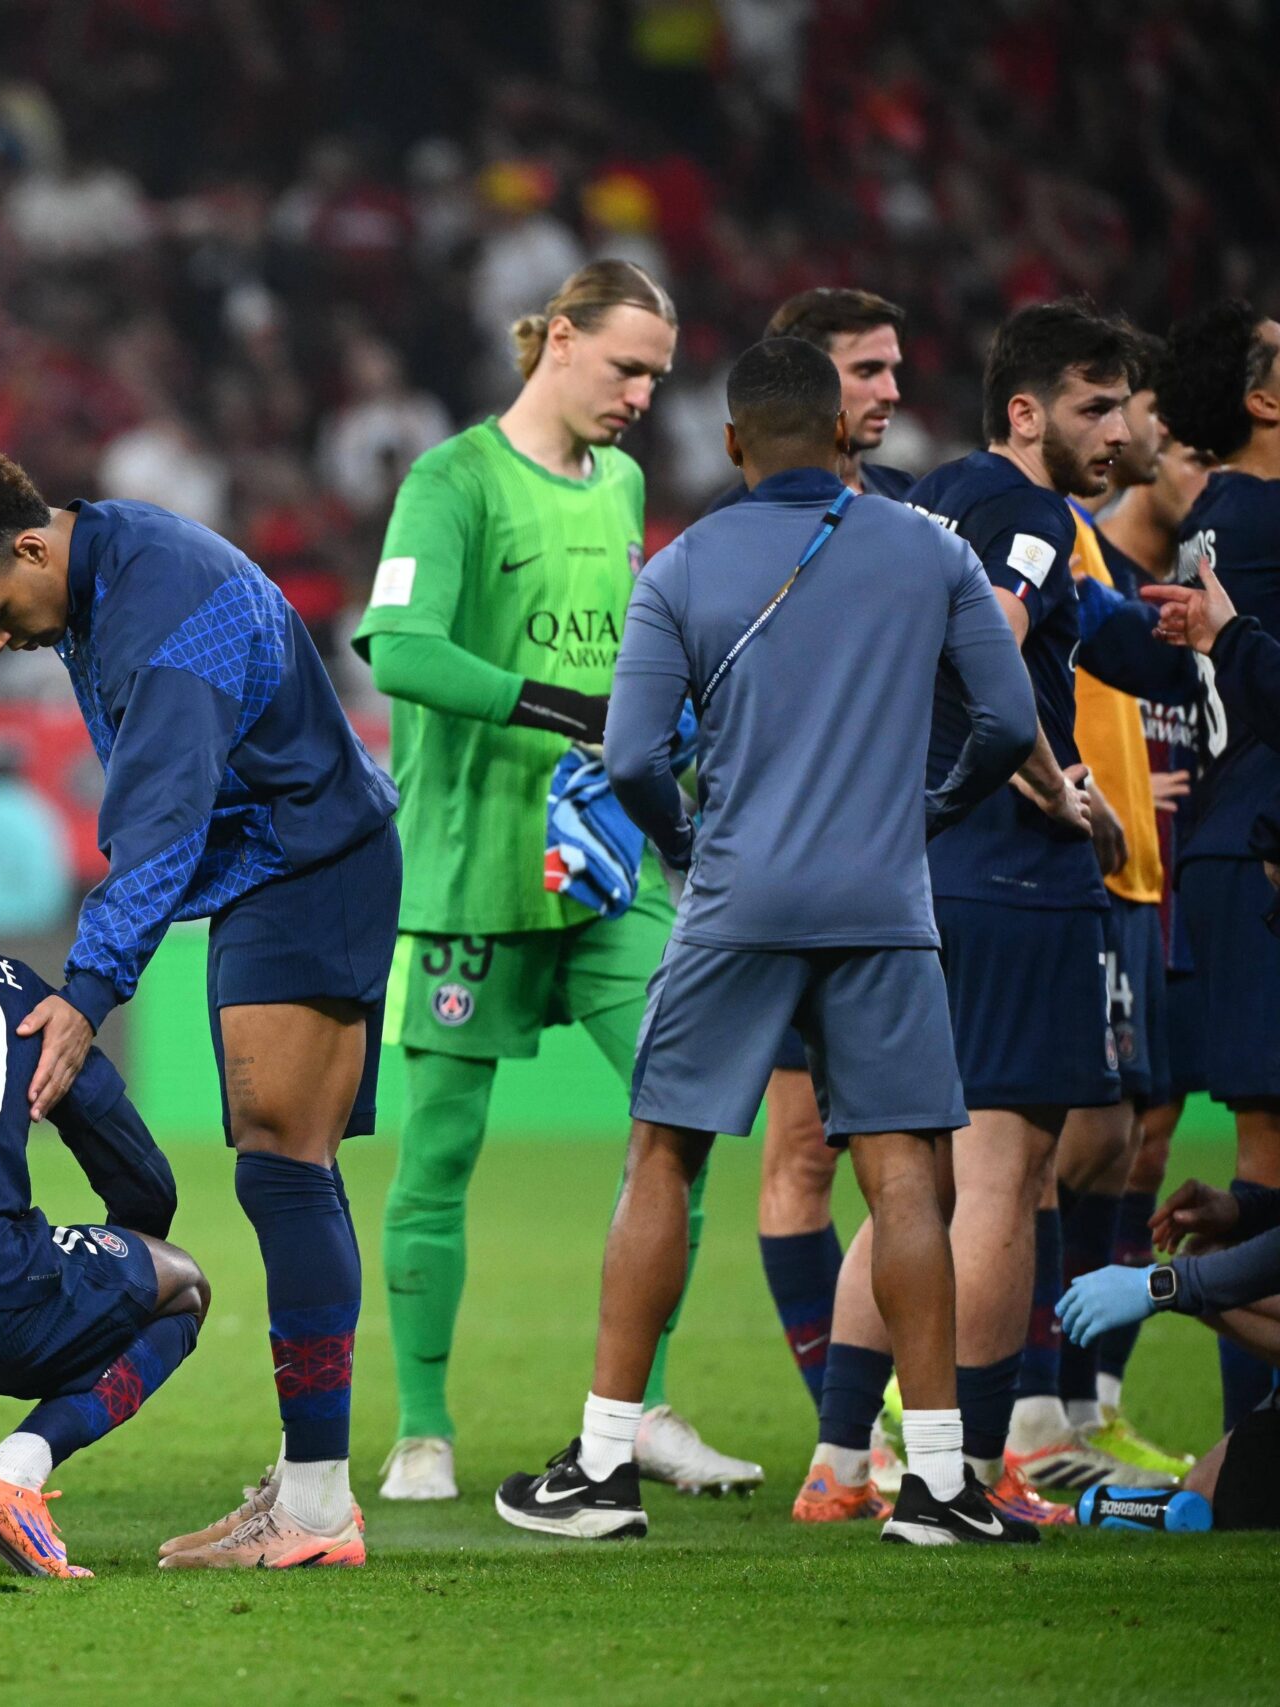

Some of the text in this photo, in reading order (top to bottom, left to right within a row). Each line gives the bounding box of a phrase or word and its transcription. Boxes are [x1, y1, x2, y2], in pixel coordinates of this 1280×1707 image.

[527, 610, 620, 652] QATA
[726, 600, 778, 662] INTERCONTINENTAL
[718, 660, 729, 675] CUP
[705, 672, 721, 694] QATAR
[1100, 1500, 1159, 1518] POWERADE
